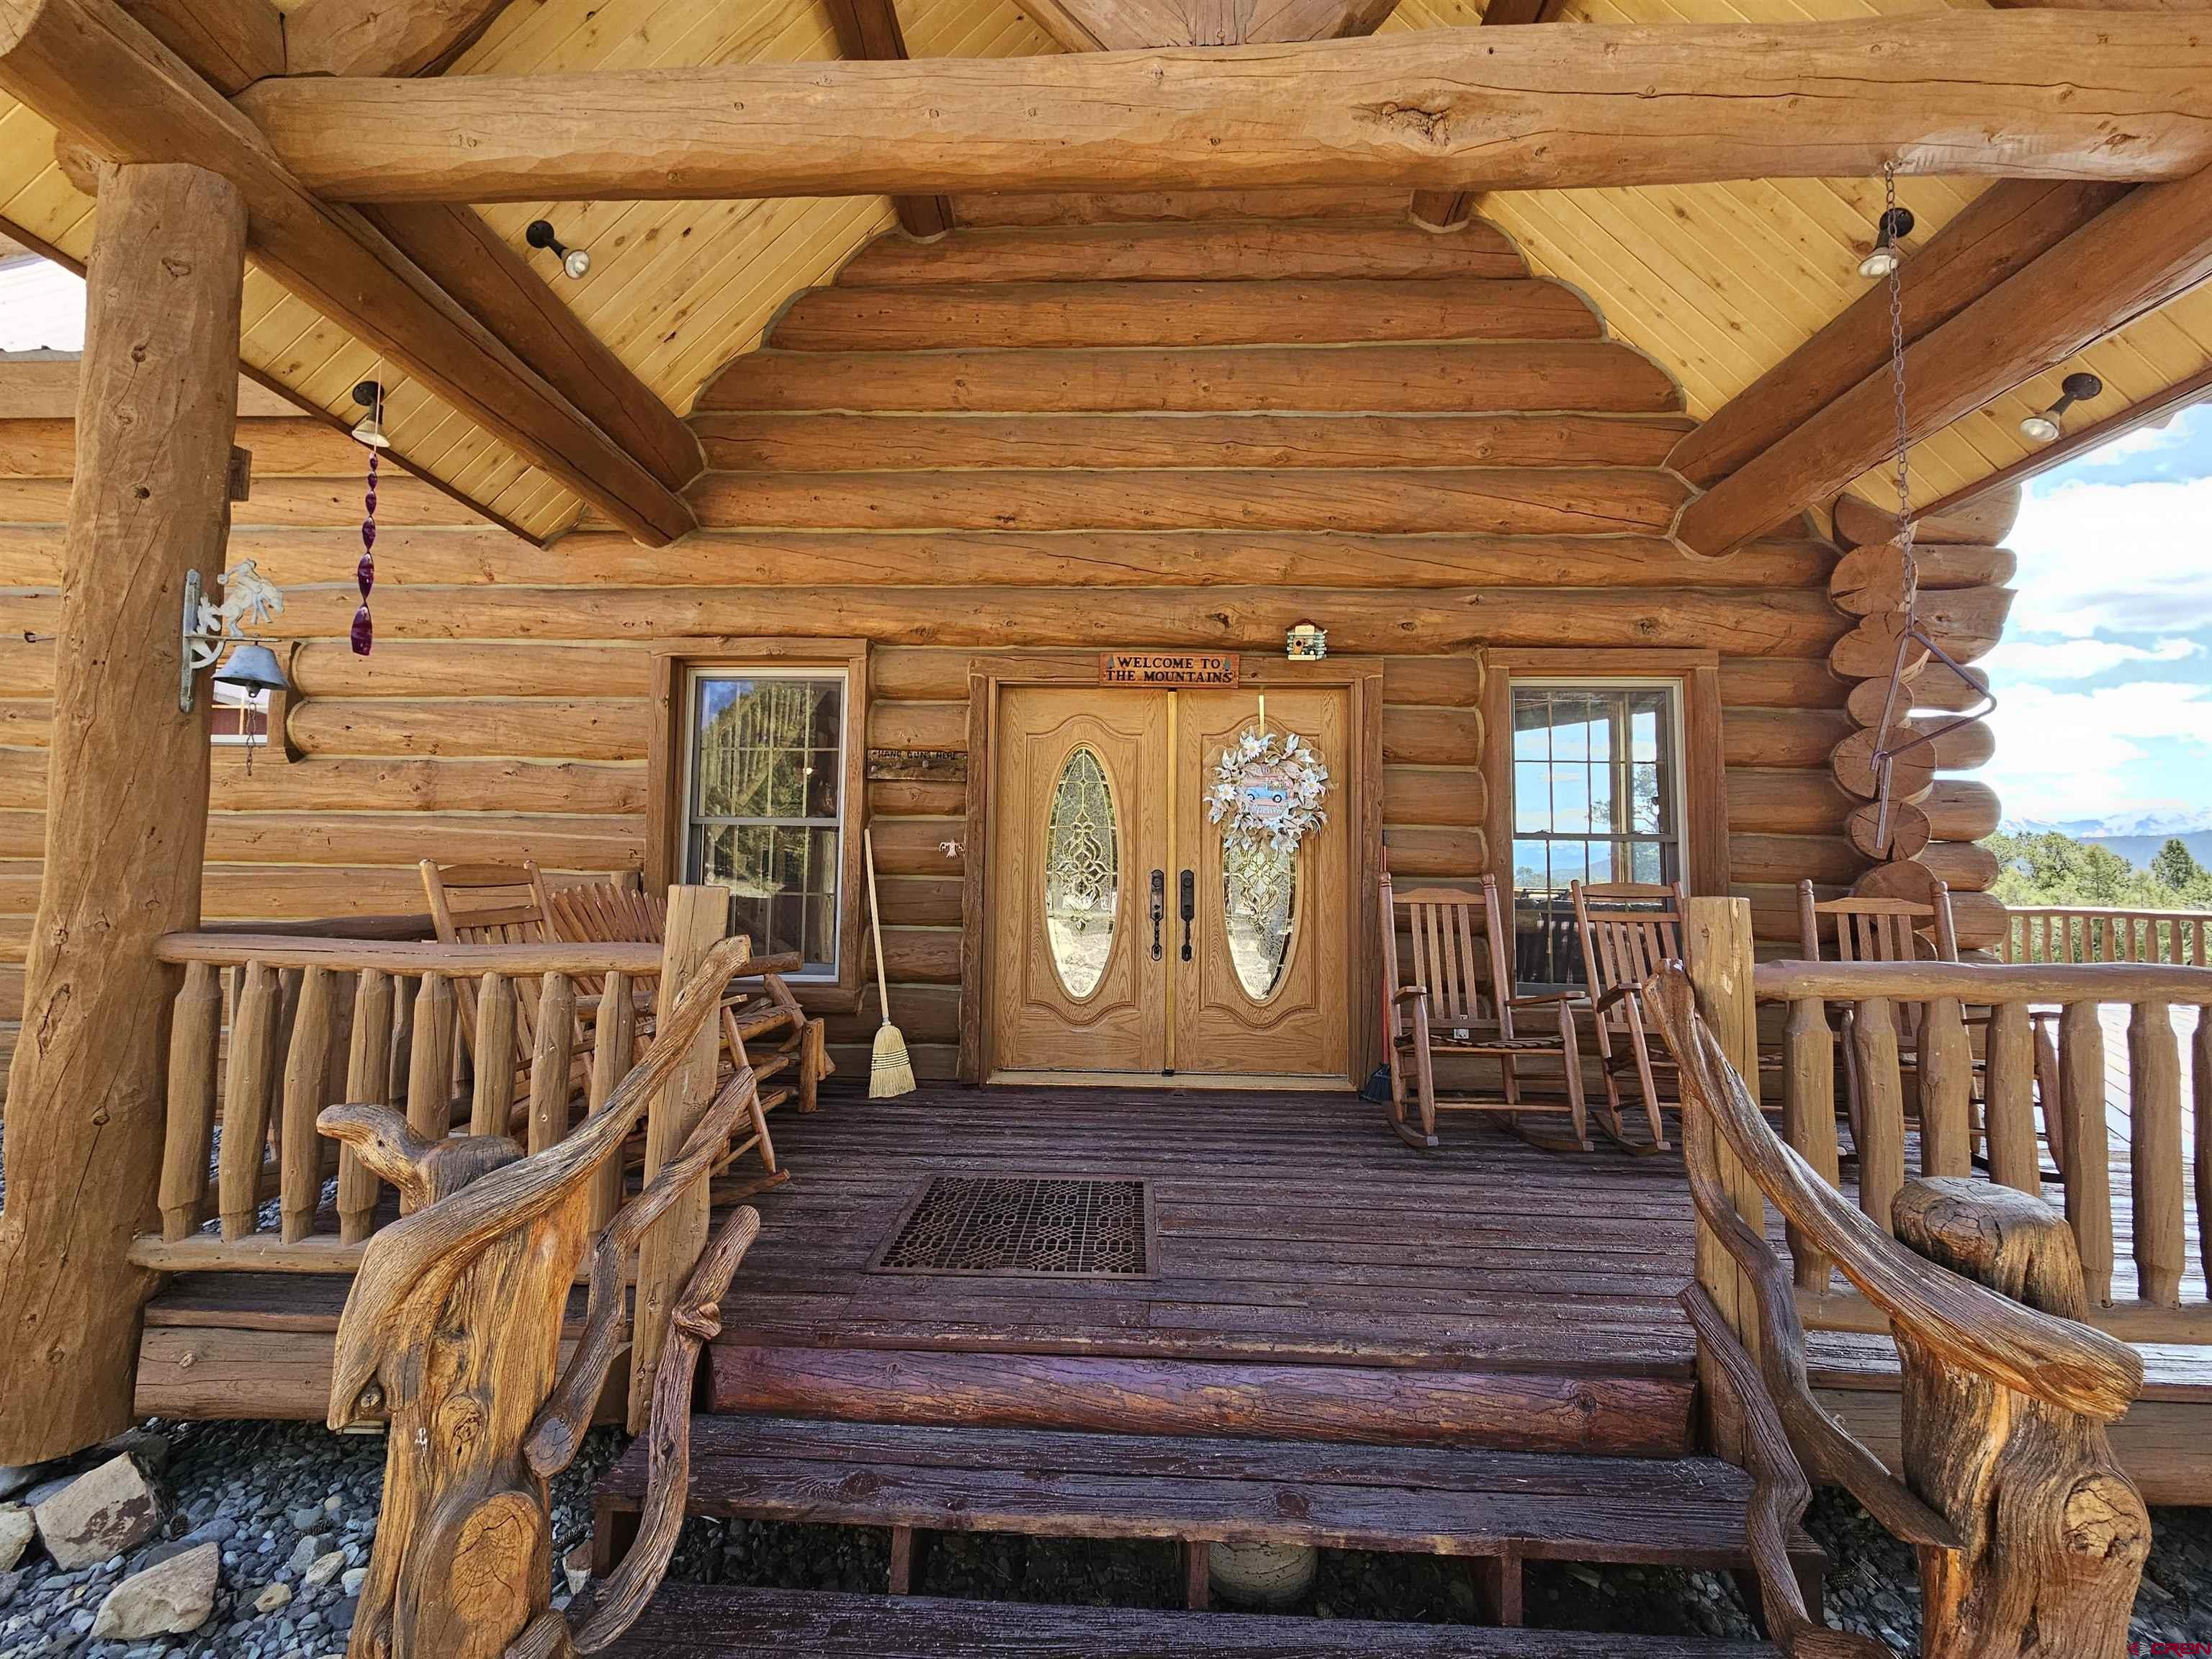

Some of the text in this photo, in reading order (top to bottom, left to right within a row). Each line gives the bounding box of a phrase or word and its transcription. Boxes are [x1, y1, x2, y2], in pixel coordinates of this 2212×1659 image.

[1118, 657, 1220, 669] WELCOME TO
[1106, 670, 1233, 683] THE MOUNTAINS
